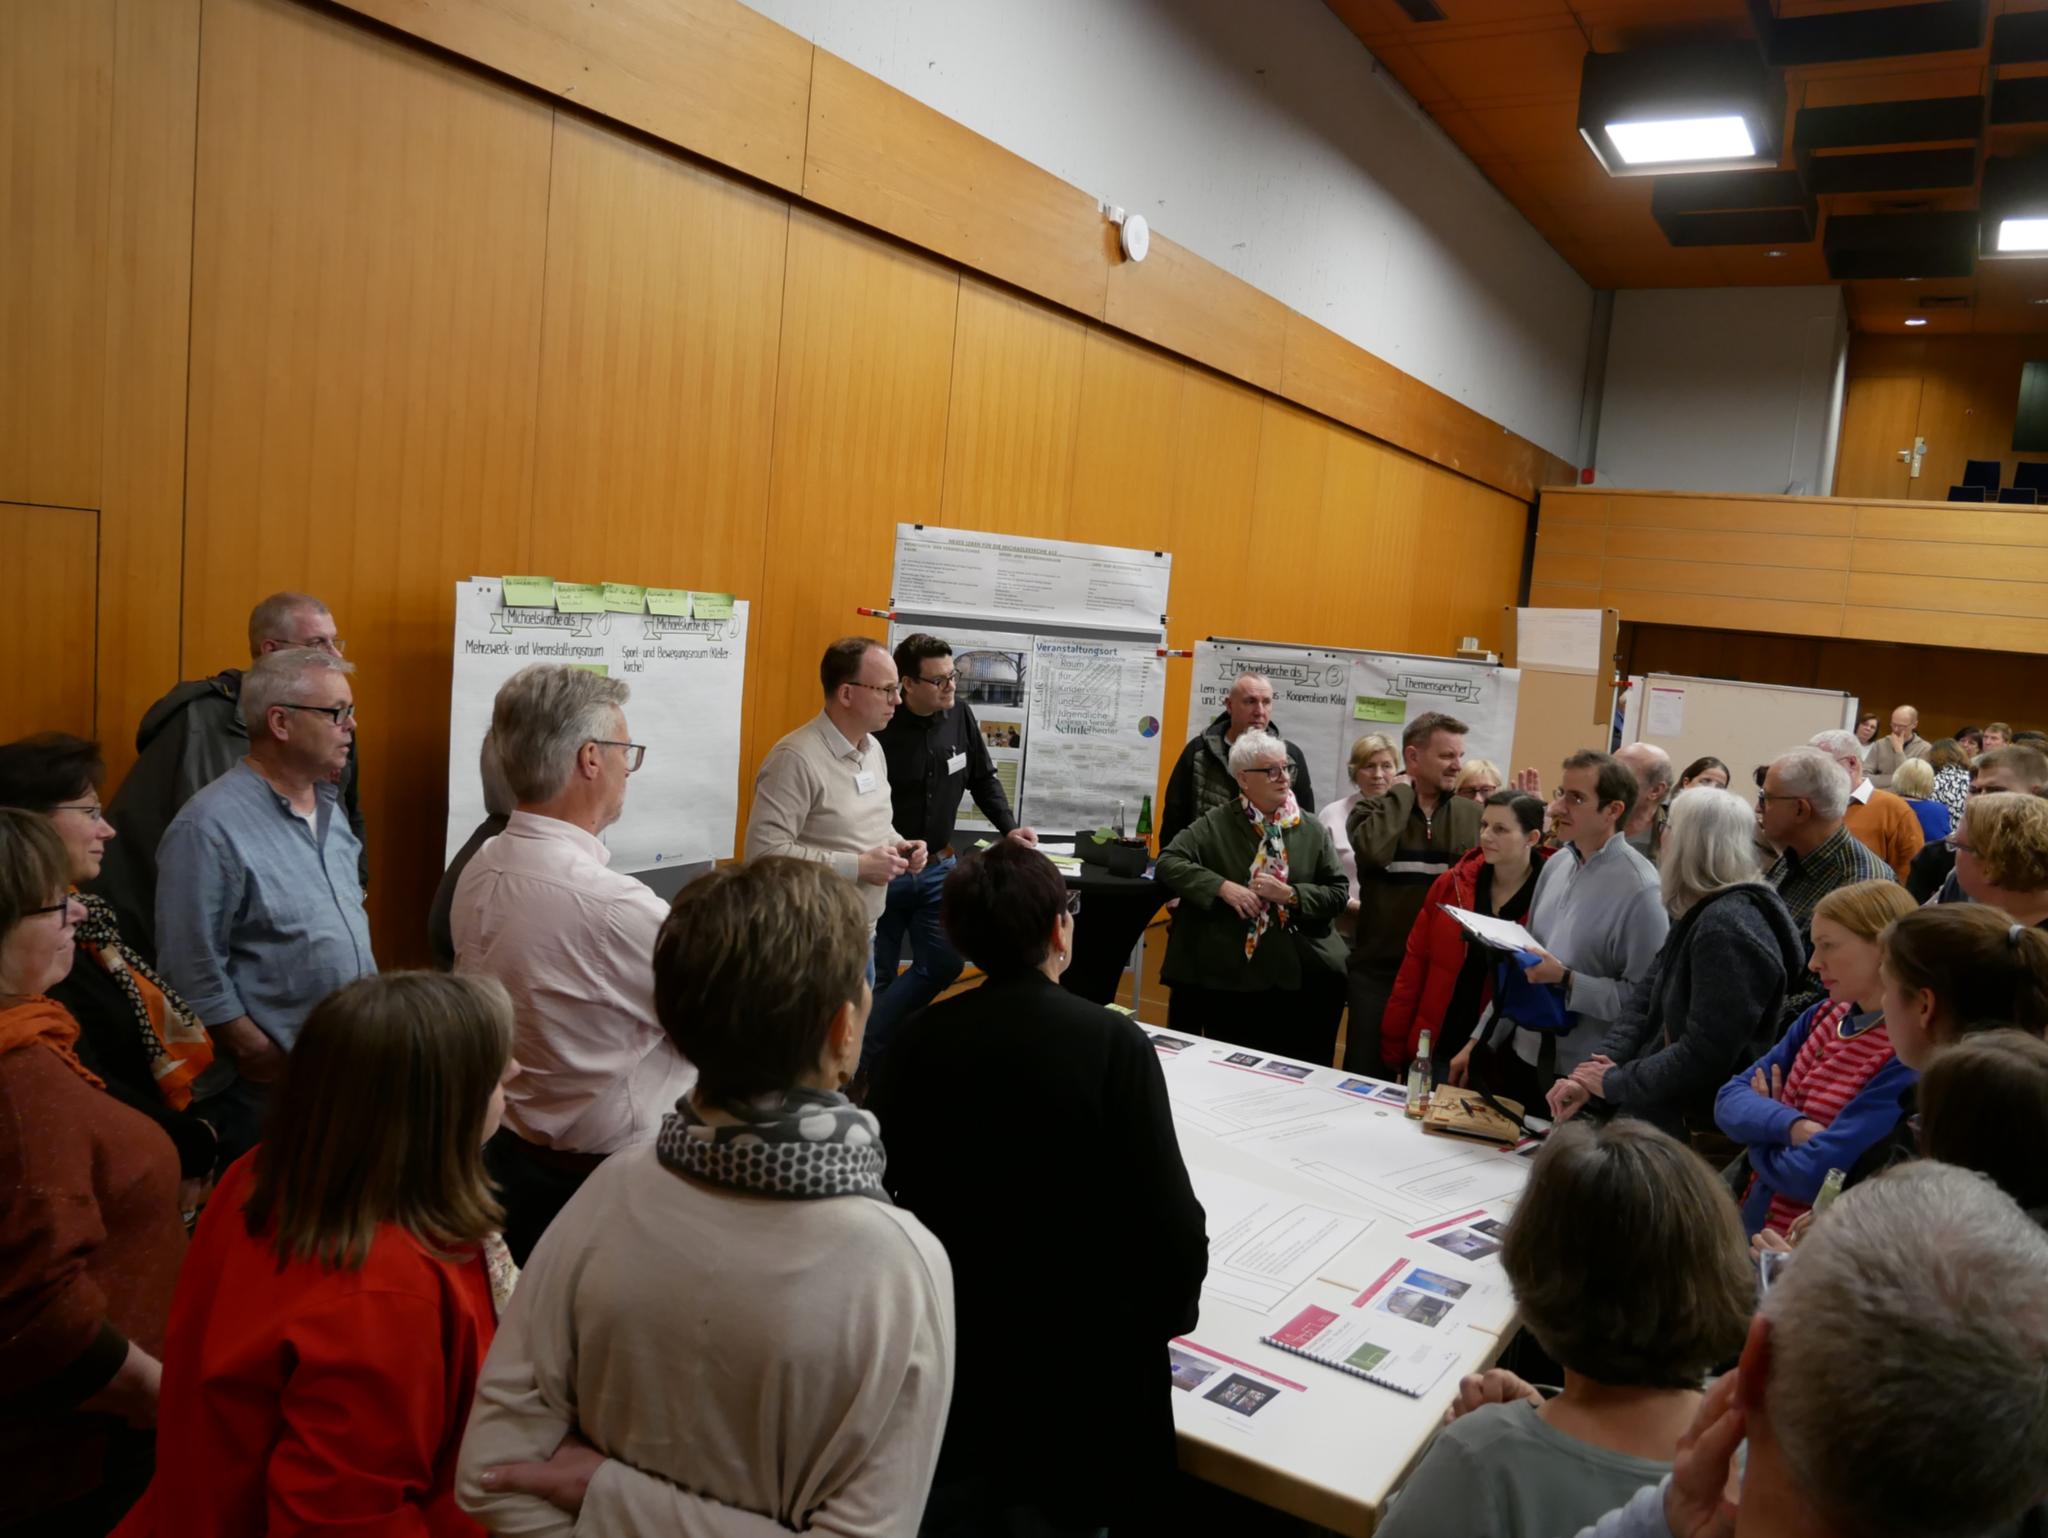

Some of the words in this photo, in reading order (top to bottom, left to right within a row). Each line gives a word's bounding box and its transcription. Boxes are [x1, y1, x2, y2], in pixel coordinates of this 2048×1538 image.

[465, 639, 512, 655] Mehrzweck-
[514, 641, 529, 655] und
[532, 642, 604, 659] Veranstaltungsraum
[642, 647, 655, 659] und
[657, 648, 708, 661] Bewegungsraum
[1036, 643, 1118, 656] Veranstaltungsort
[1060, 659, 1084, 668] Raum
[1404, 677, 1468, 694] Themenspeicher
[1201, 697, 1216, 706] und
[1286, 690, 1328, 704] Kooperation
[1057, 710, 1107, 720] Jugendliche
[1055, 723, 1089, 735] Schule
